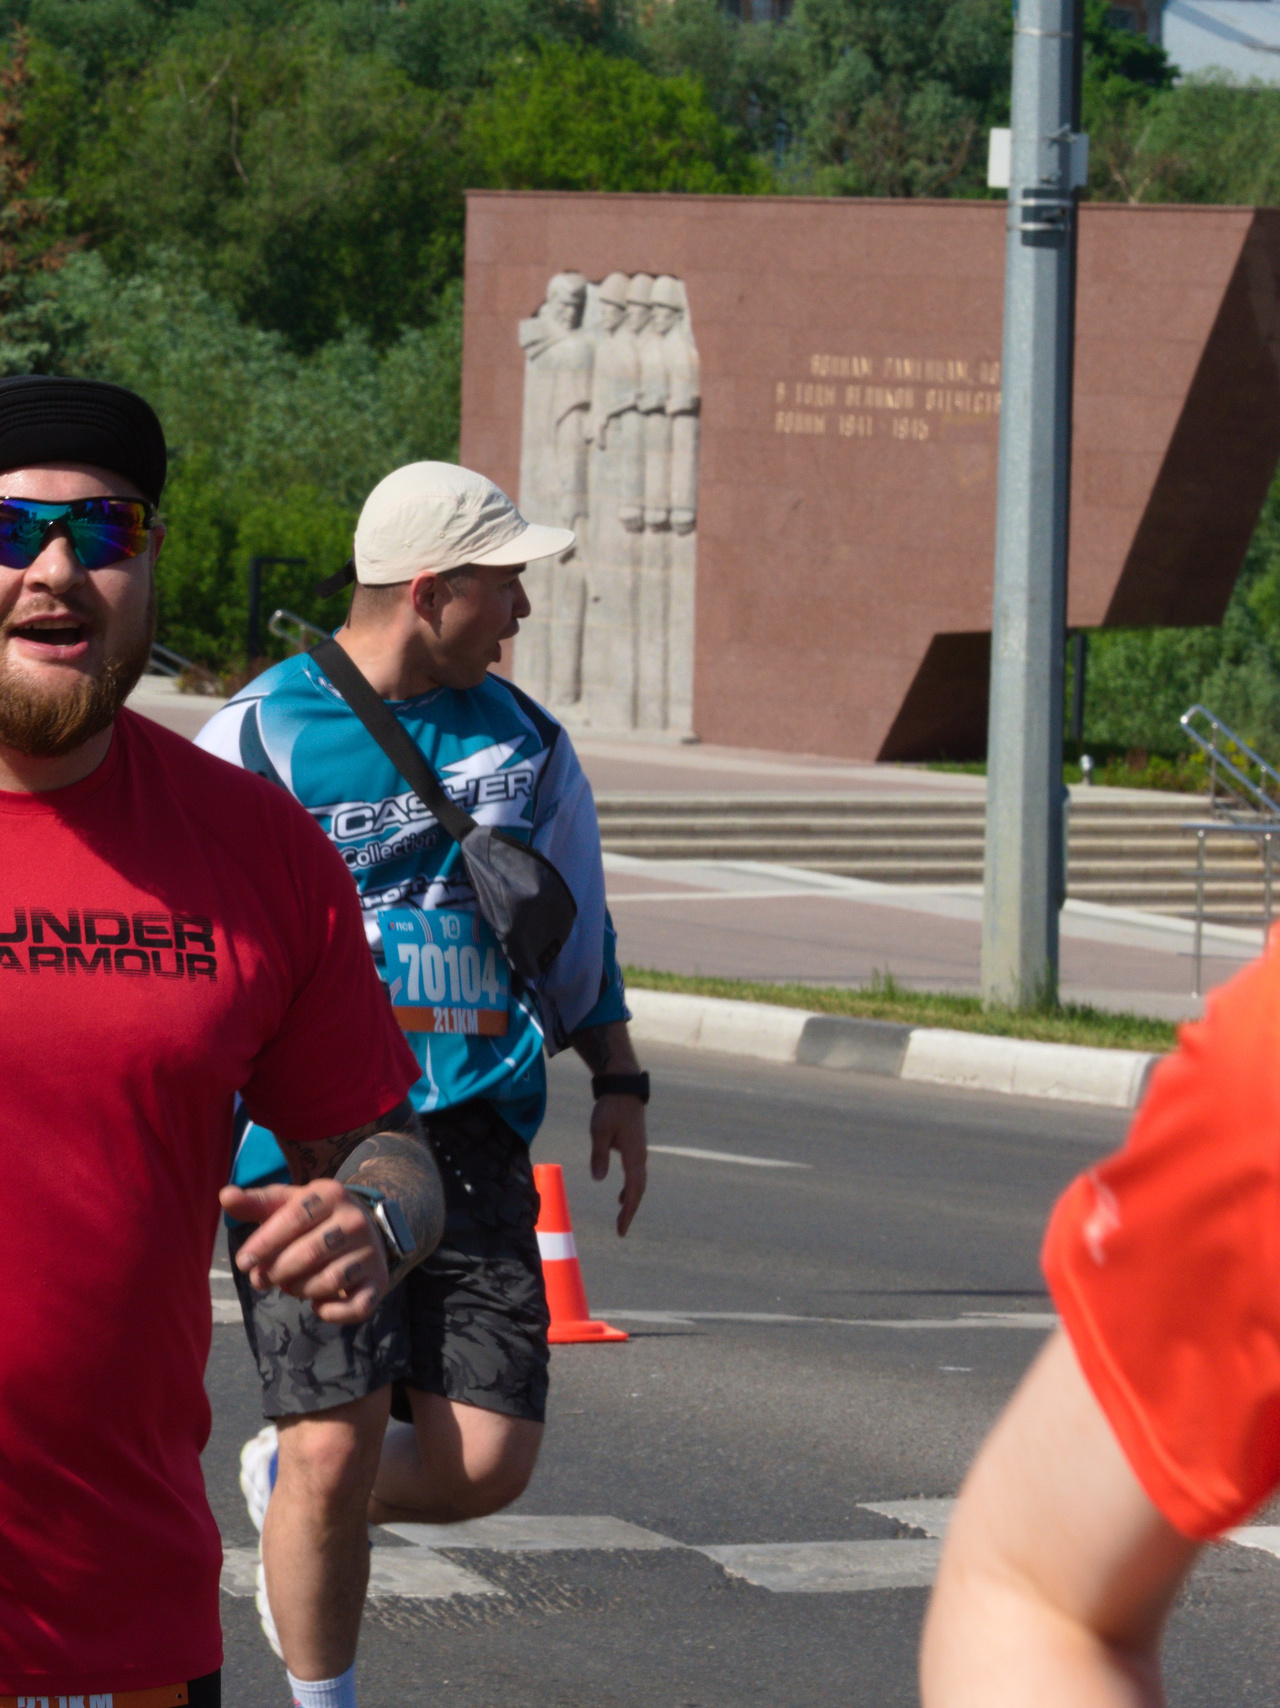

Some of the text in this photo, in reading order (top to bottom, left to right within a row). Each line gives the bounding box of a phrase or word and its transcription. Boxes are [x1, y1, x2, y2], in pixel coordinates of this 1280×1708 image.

[343, 830, 440, 869] Collection
[439, 915, 461, 940] 10
[397, 942, 499, 1004] 70104
[433, 1006, 479, 1035] 21.1KM
